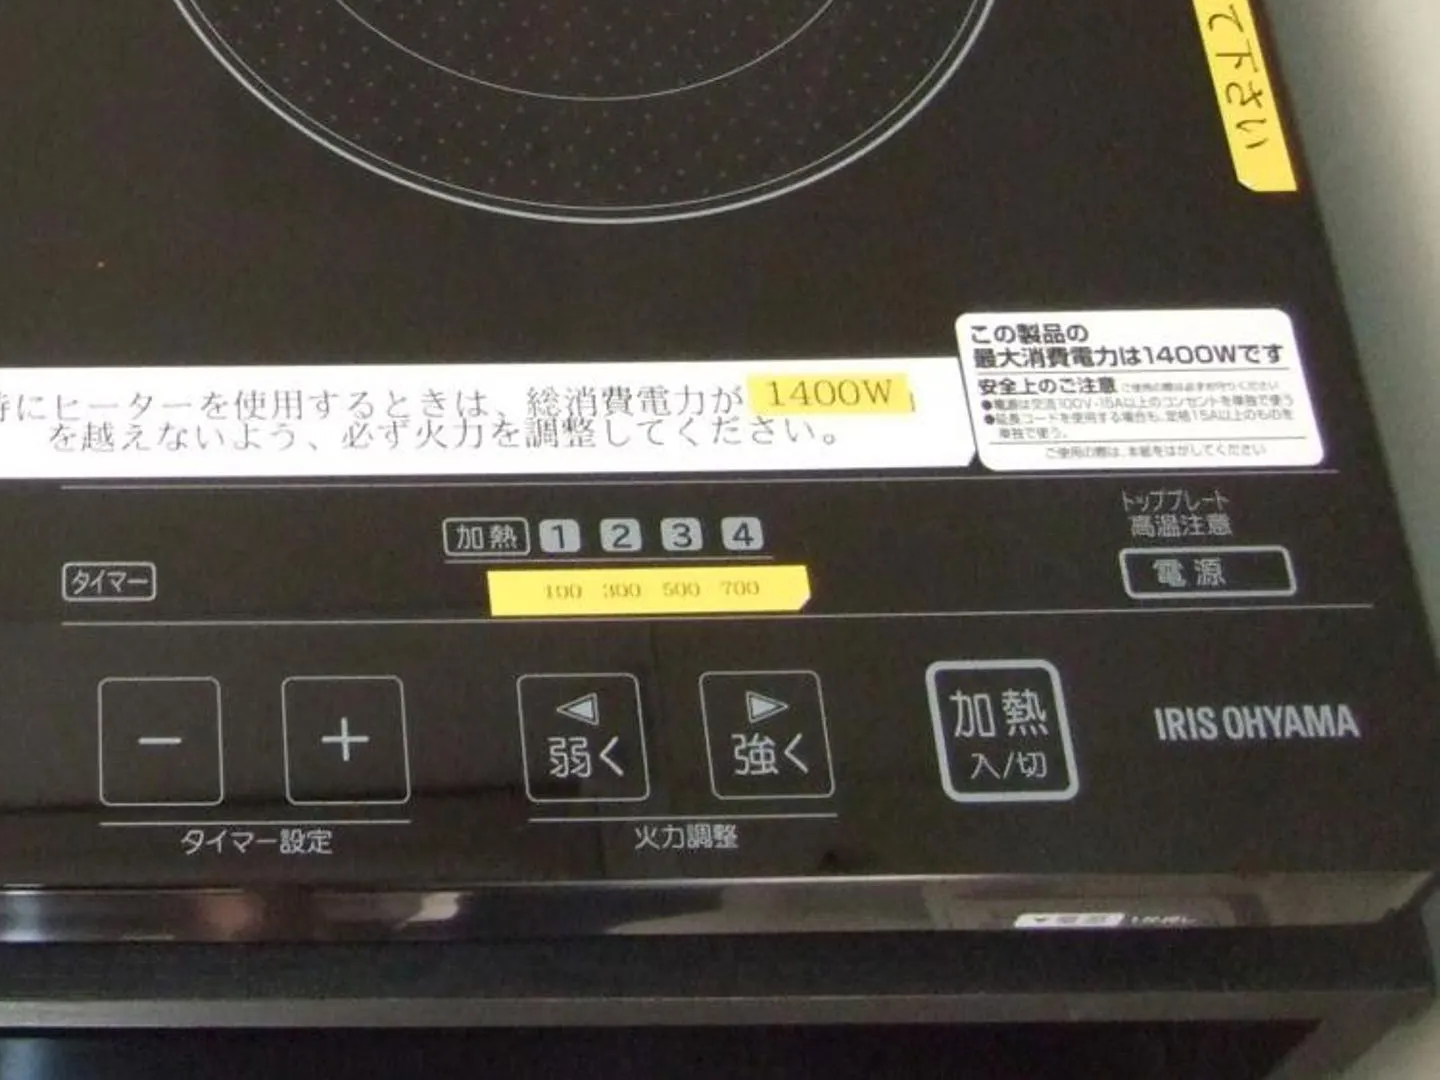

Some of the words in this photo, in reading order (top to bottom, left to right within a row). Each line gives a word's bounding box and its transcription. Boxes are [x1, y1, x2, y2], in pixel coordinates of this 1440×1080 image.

[970, 323, 1089, 344] この製品の
[973, 344, 1284, 369] 最大消費電力は1400Wです
[977, 376, 1117, 396] 安全上のご注意
[47, 416, 838, 453] を越えないよう、必ず火力を調整してください。
[1121, 488, 1230, 512] トッププレート
[456, 525, 518, 551] 加熱
[611, 524, 633, 549] 2
[672, 523, 693, 548] 3
[732, 522, 755, 547] 4
[1128, 513, 1233, 538] 高温注意
[71, 568, 149, 595] タイマー
[1152, 558, 1228, 588] 電源
[544, 584, 583, 600] 100
[662, 581, 701, 598] 500
[721, 580, 760, 597] 700
[949, 687, 1050, 739] 加熱
[1153, 706, 1219, 741] IRIS
[1222, 703, 1360, 740] OHYAMA
[546, 735, 625, 779] 弱く
[731, 732, 810, 776] 強く
[970, 750, 1048, 780] 入/切
[180, 828, 334, 856] タイマー設定
[634, 822, 740, 850] 火力調整
